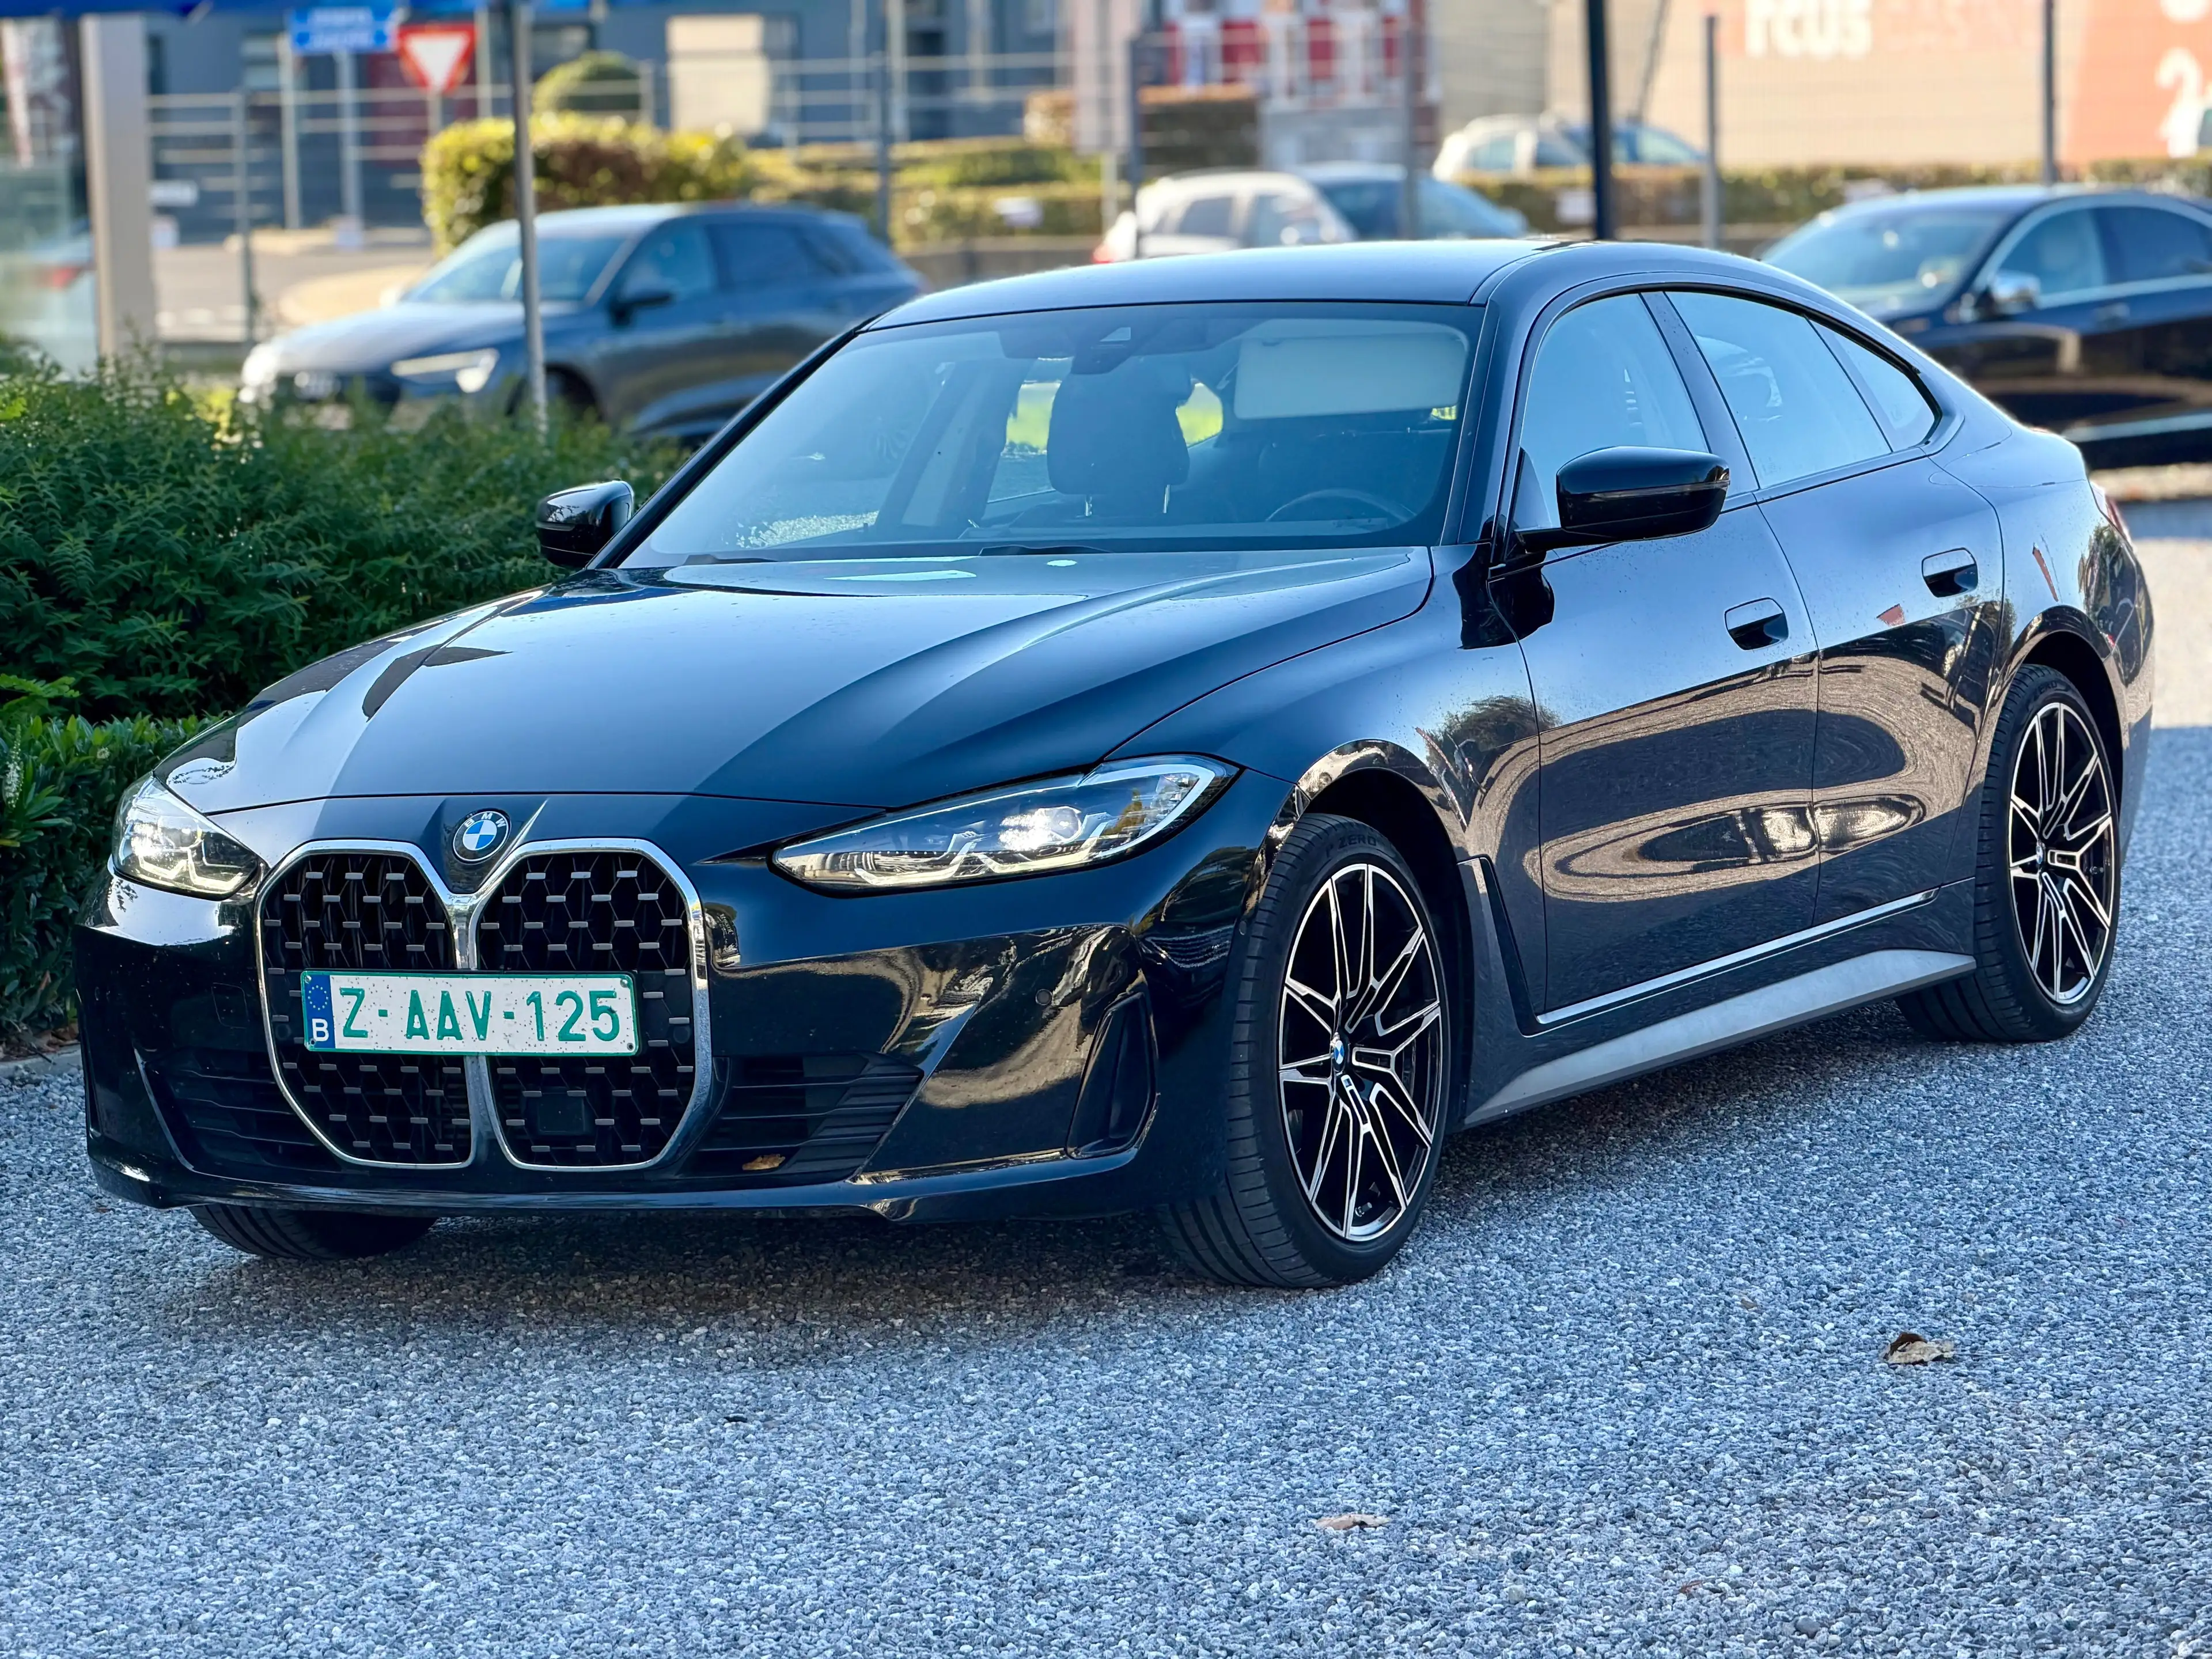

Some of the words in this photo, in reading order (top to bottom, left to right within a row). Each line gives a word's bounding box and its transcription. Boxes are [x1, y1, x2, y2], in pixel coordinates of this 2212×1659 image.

[465, 812, 507, 828] BMW
[1338, 834, 1377, 849] ZERO
[339, 987, 620, 1041] Z-AAV-125
[312, 1018, 329, 1041] B
